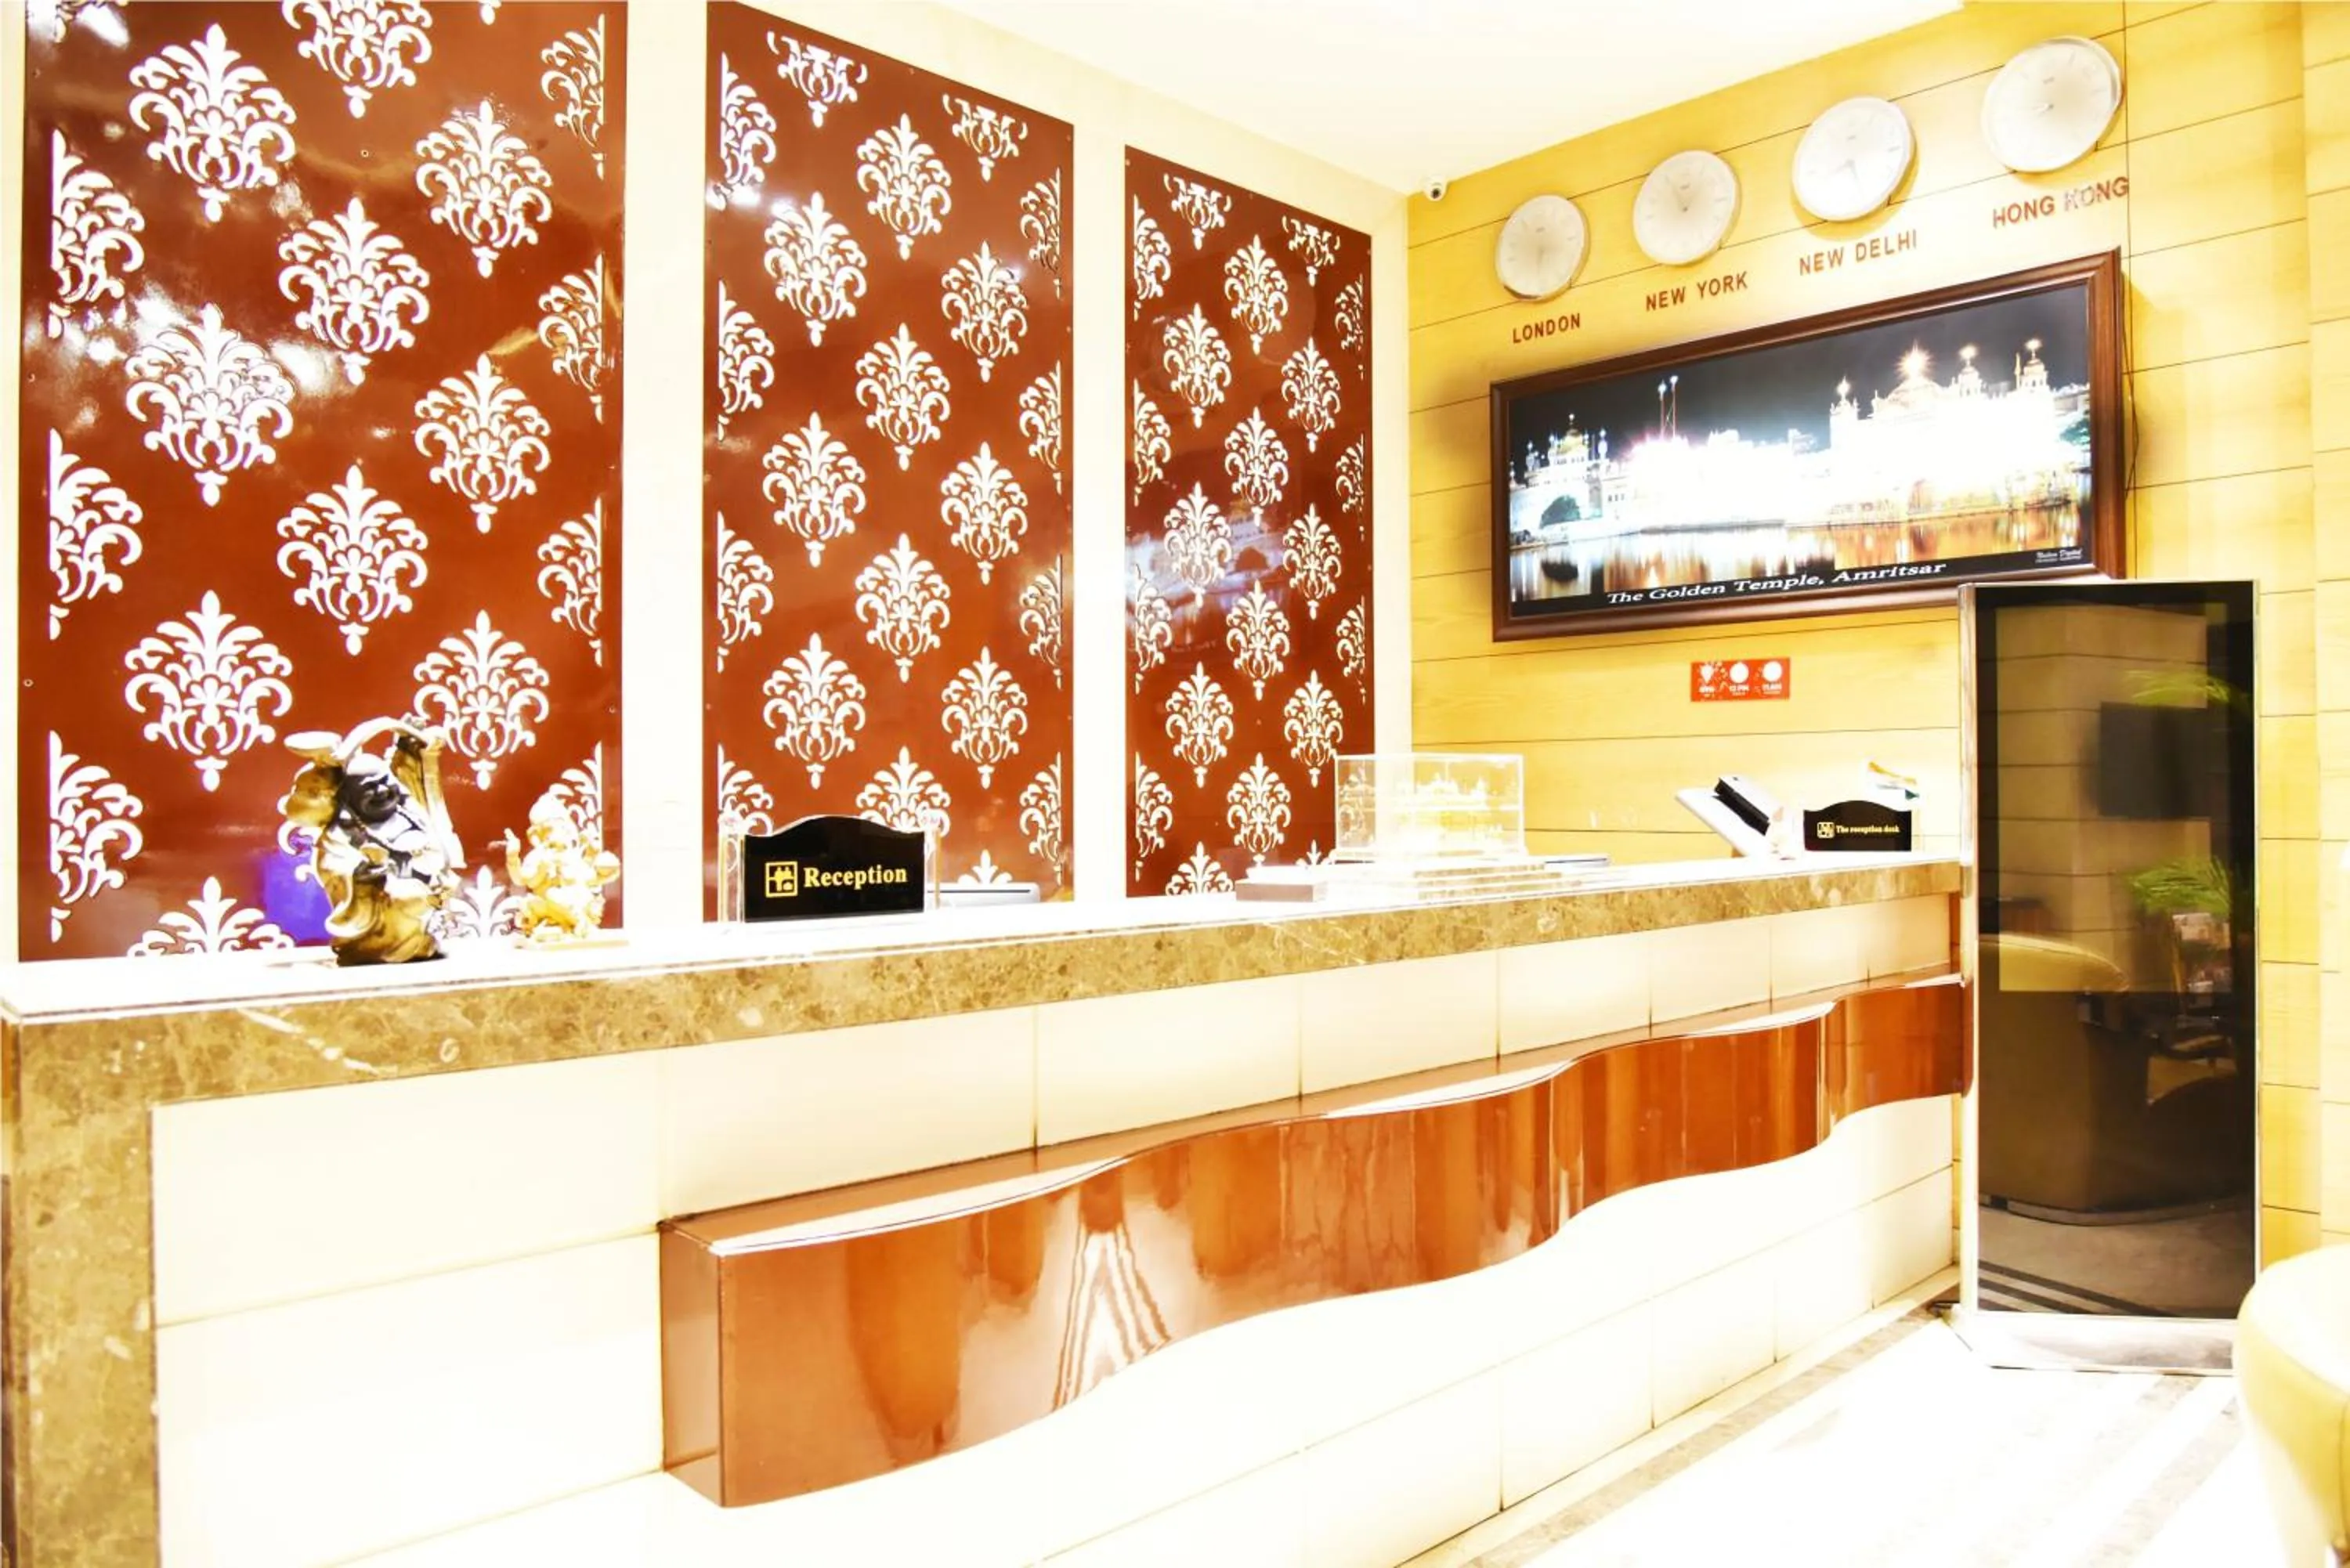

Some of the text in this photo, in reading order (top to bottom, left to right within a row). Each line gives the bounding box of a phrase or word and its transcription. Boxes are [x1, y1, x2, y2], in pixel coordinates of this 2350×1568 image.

[1993, 176, 2130, 229] HONG KONG
[1799, 229, 1917, 276] NEW DELHI
[1646, 270, 1748, 312] NEW YORK
[1513, 312, 1581, 345] LONDON
[1607, 563, 1947, 604] The Golden Temple, Amritsar
[1835, 825, 1849, 833] The
[803, 865, 907, 890] Reception
